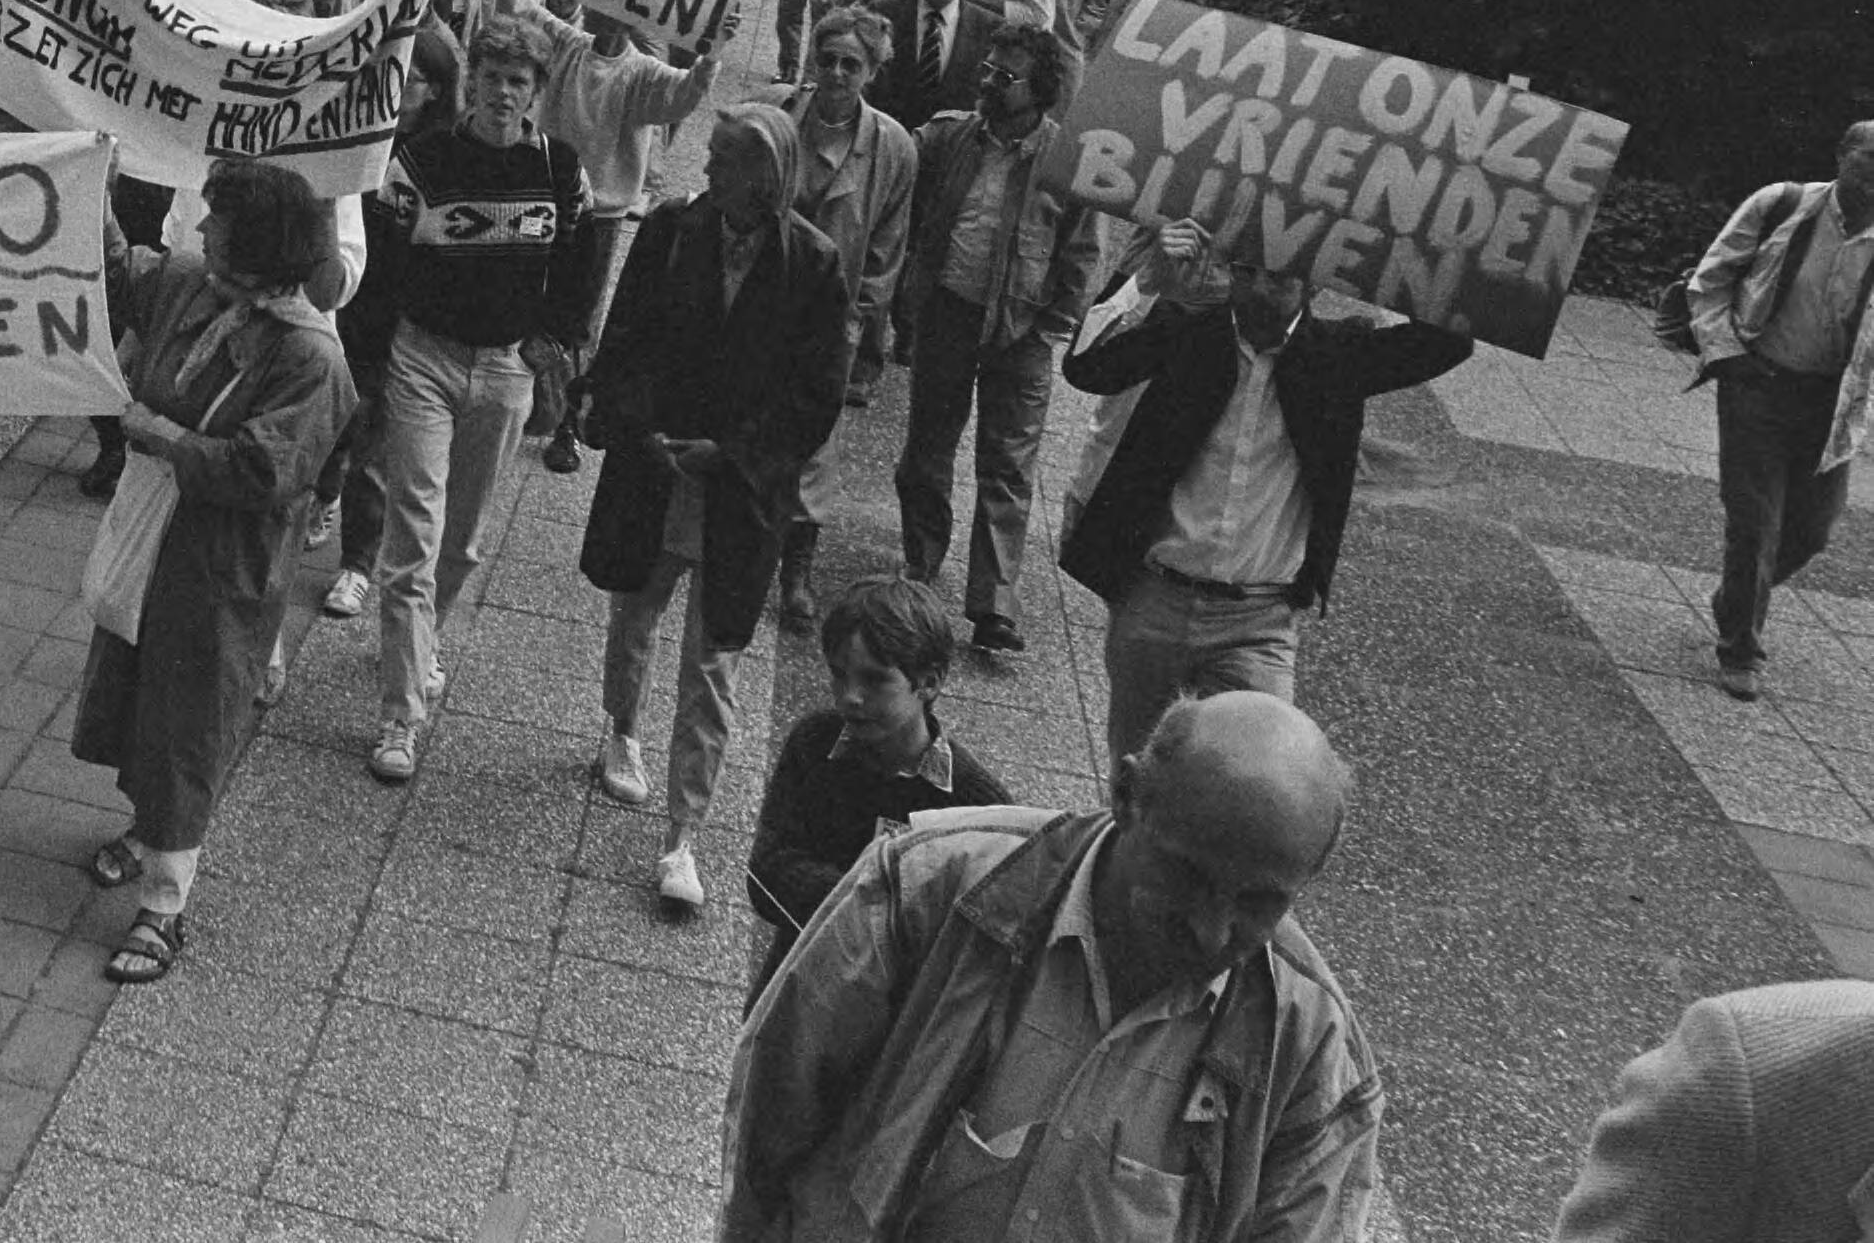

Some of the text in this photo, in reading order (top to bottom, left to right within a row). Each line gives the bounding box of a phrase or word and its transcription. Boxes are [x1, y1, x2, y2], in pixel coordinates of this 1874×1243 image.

[69, 44, 136, 108] ZICH
[145, 78, 204, 123] MET
[205, 99, 302, 154] HAND
[1359, 56, 1629, 205] ONZE
[1161, 78, 1590, 293] VRIENDEN
